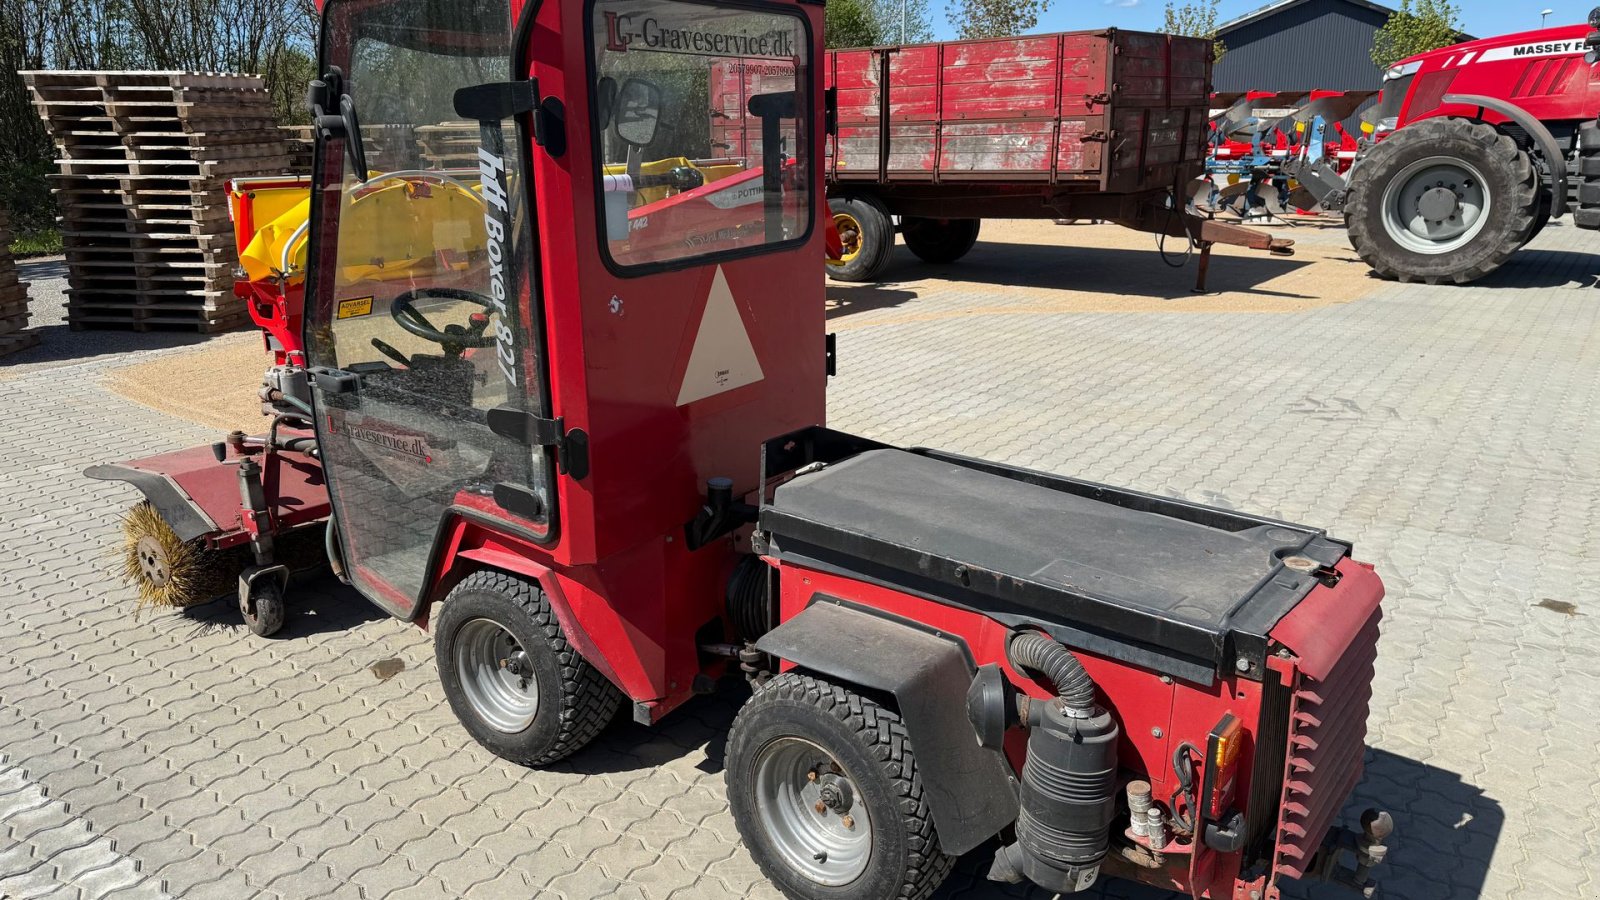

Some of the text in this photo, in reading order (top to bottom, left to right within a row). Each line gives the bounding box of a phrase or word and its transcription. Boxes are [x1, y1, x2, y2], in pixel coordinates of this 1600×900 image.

[1513, 42, 1571, 56] MASSEY
[632, 216, 649, 231] 442
[484, 213, 509, 318] Boxer
[341, 300, 370, 309] ADVARSEL
[495, 319, 517, 387] 827
